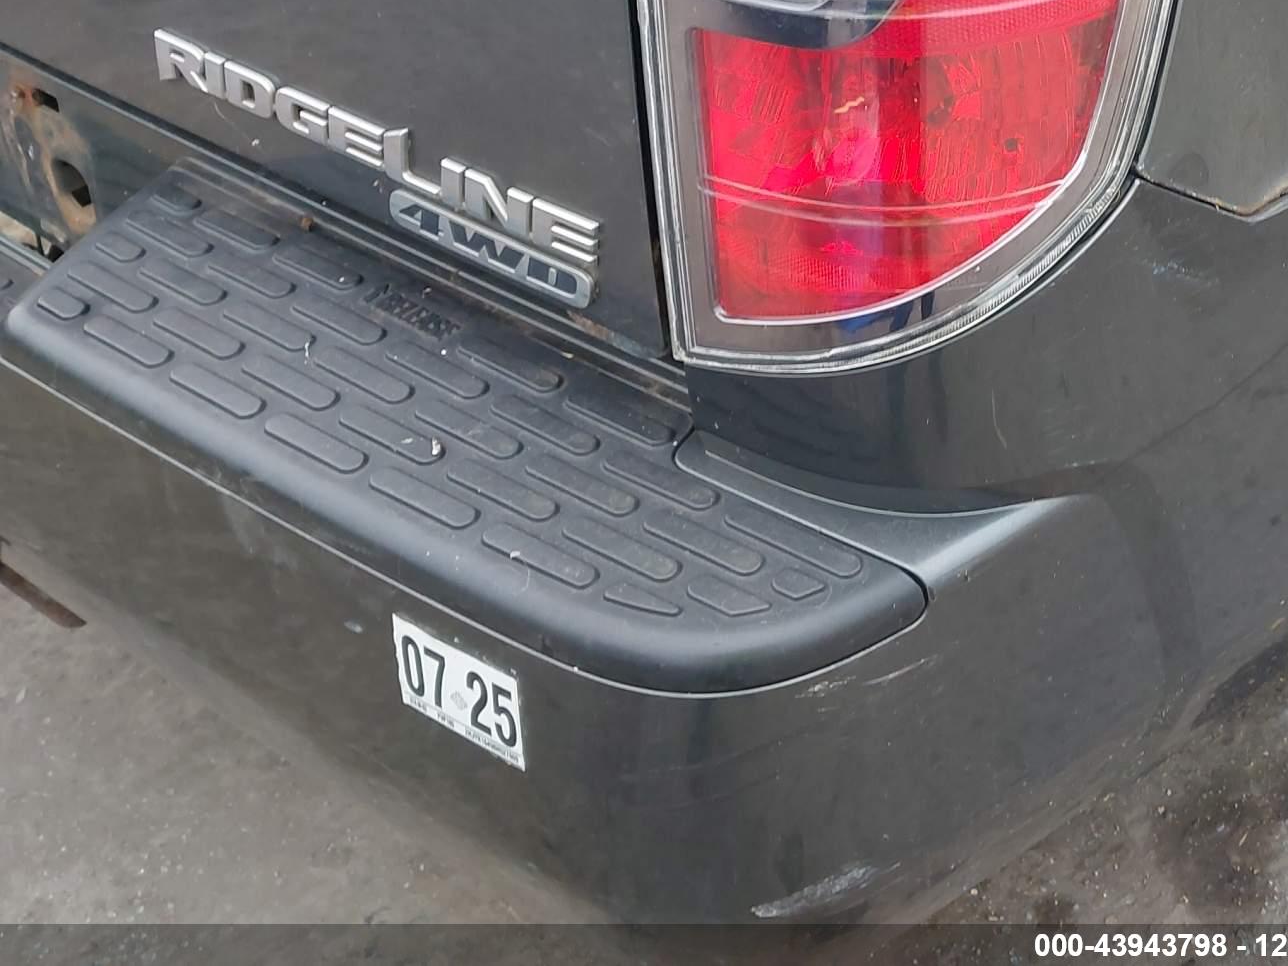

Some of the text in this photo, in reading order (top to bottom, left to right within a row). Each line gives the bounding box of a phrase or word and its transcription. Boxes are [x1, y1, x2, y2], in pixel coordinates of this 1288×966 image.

[154, 28, 601, 264] RIDGELINE
[398, 202, 580, 300] 4WD
[401, 634, 446, 710] 07
[466, 670, 518, 748] 25
